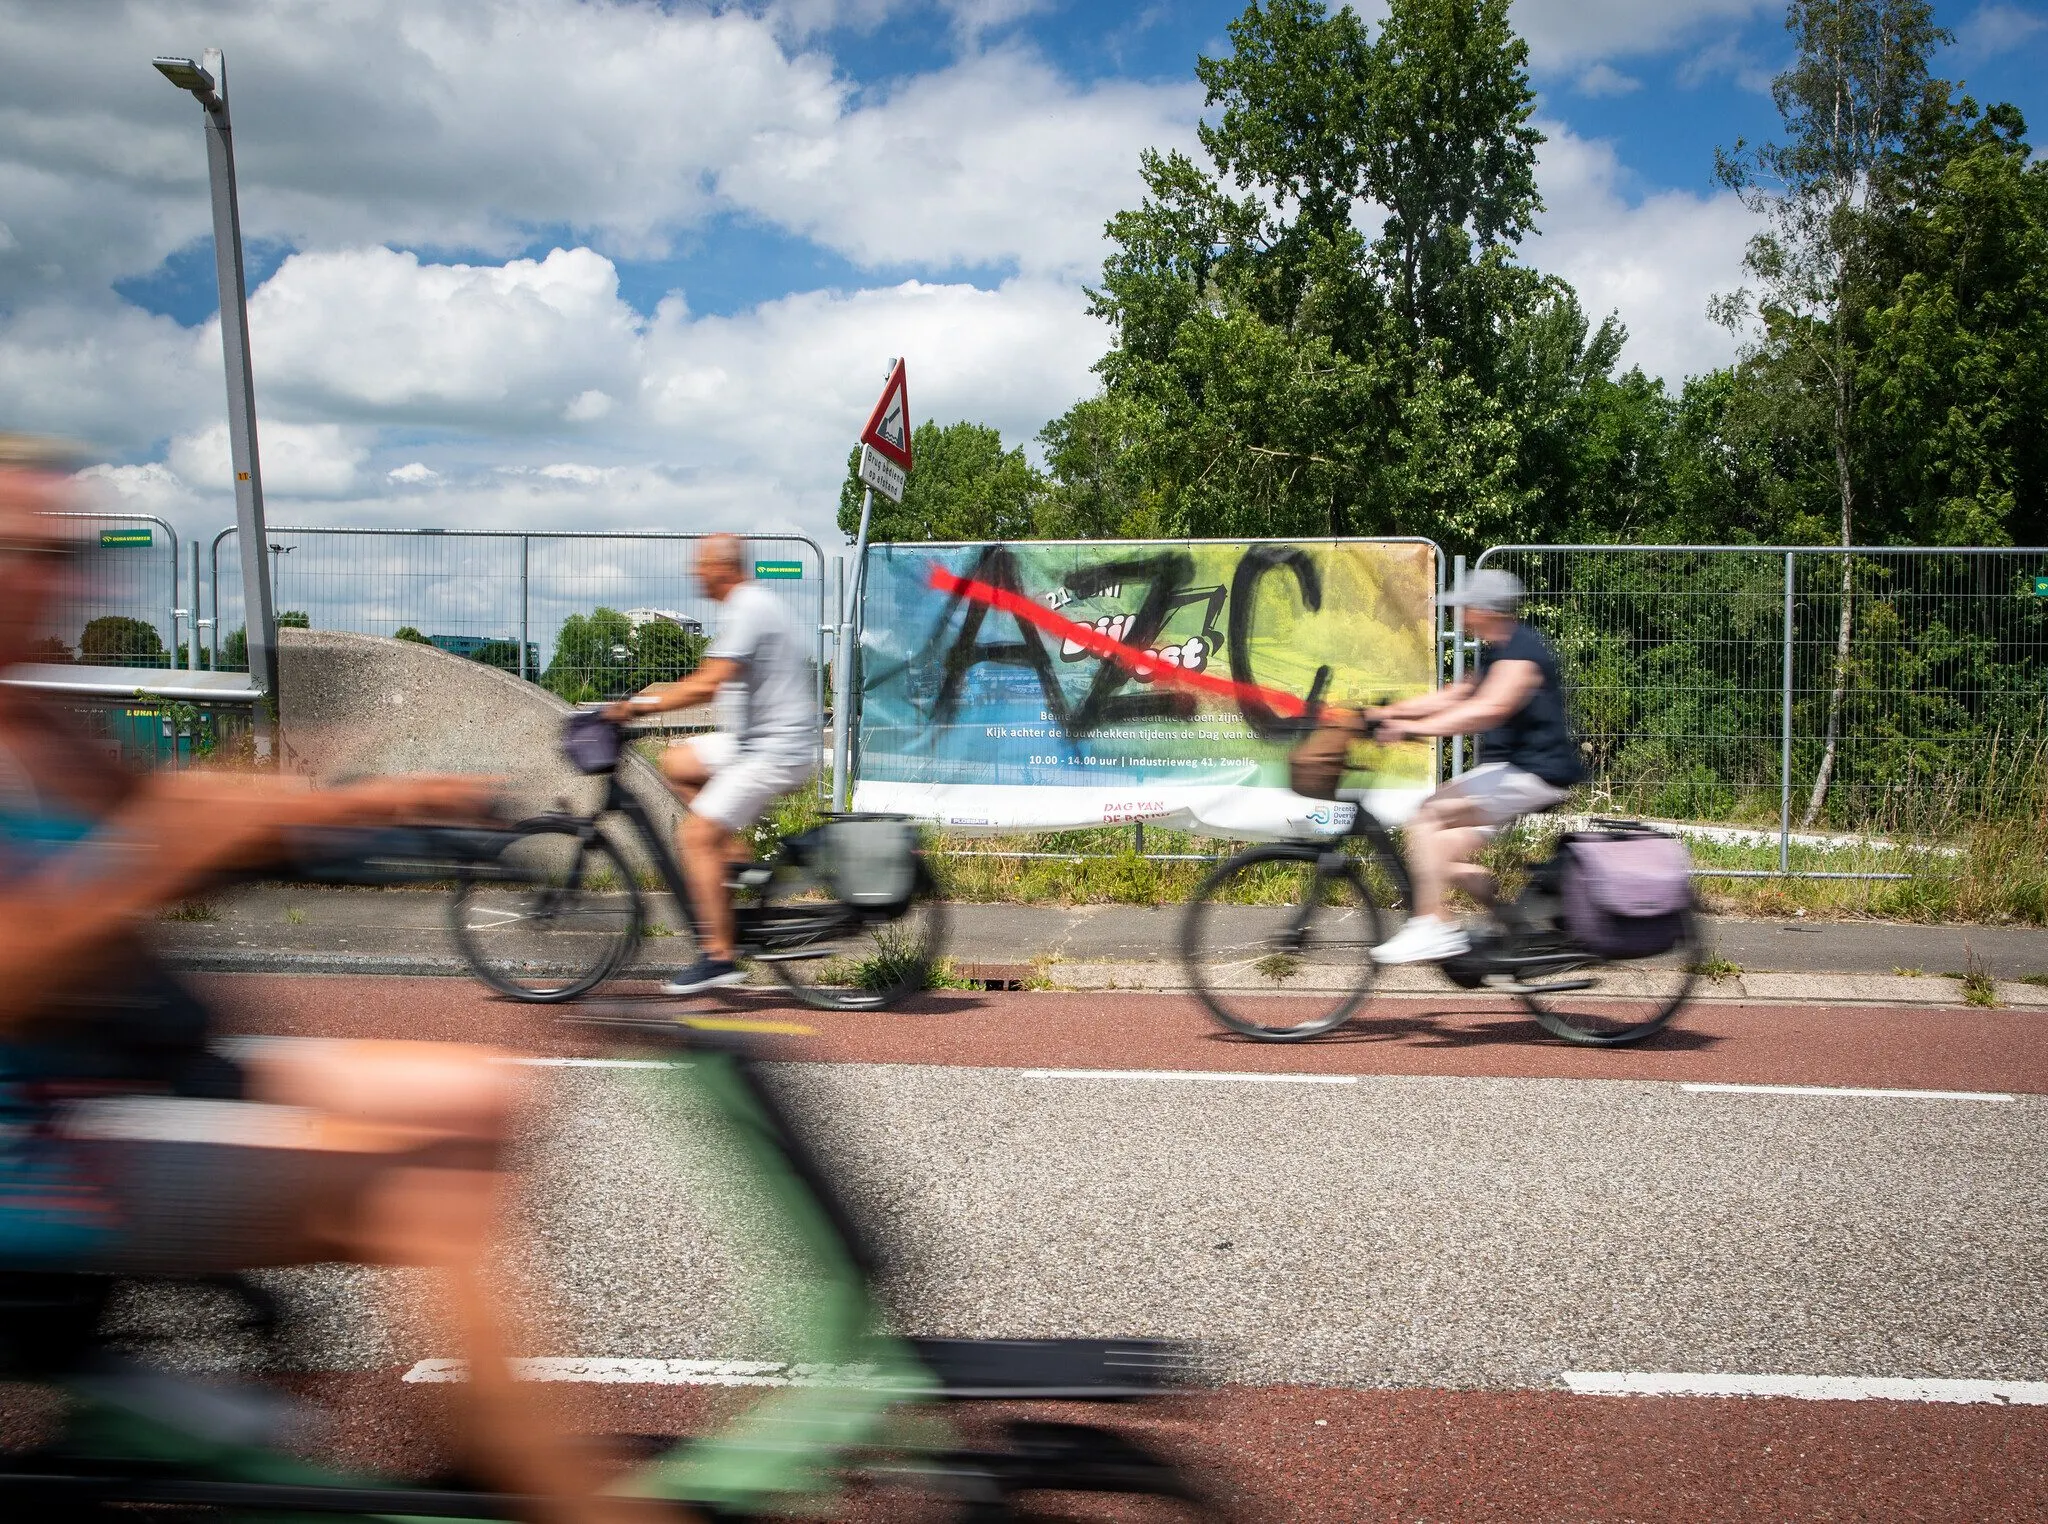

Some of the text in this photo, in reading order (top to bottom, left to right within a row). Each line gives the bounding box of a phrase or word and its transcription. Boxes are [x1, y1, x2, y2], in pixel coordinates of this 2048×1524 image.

[868, 451, 904, 485] Brug bediend
[868, 470, 898, 496] op afstand
[1045, 586, 1071, 611] 21
[931, 543, 1332, 748] AZC
[1218, 712, 1244, 724] zijn?
[986, 728, 1007, 739] Kijk
[1010, 728, 1045, 738] achter
[1048, 728, 1062, 738] de
[1065, 728, 1136, 739] bouwhekken
[1139, 729, 1177, 741] tijdens
[1180, 729, 1194, 739] de
[1198, 730, 1219, 741] Dag
[1246, 730, 1260, 739] de
[1029, 756, 1058, 765] 10.00
[1068, 756, 1096, 765] 14.00
[1099, 758, 1117, 766] uur
[1129, 757, 1198, 768] Industrieweg
[1201, 758, 1217, 768] 41,
[1104, 801, 1164, 812] DAG VAN
